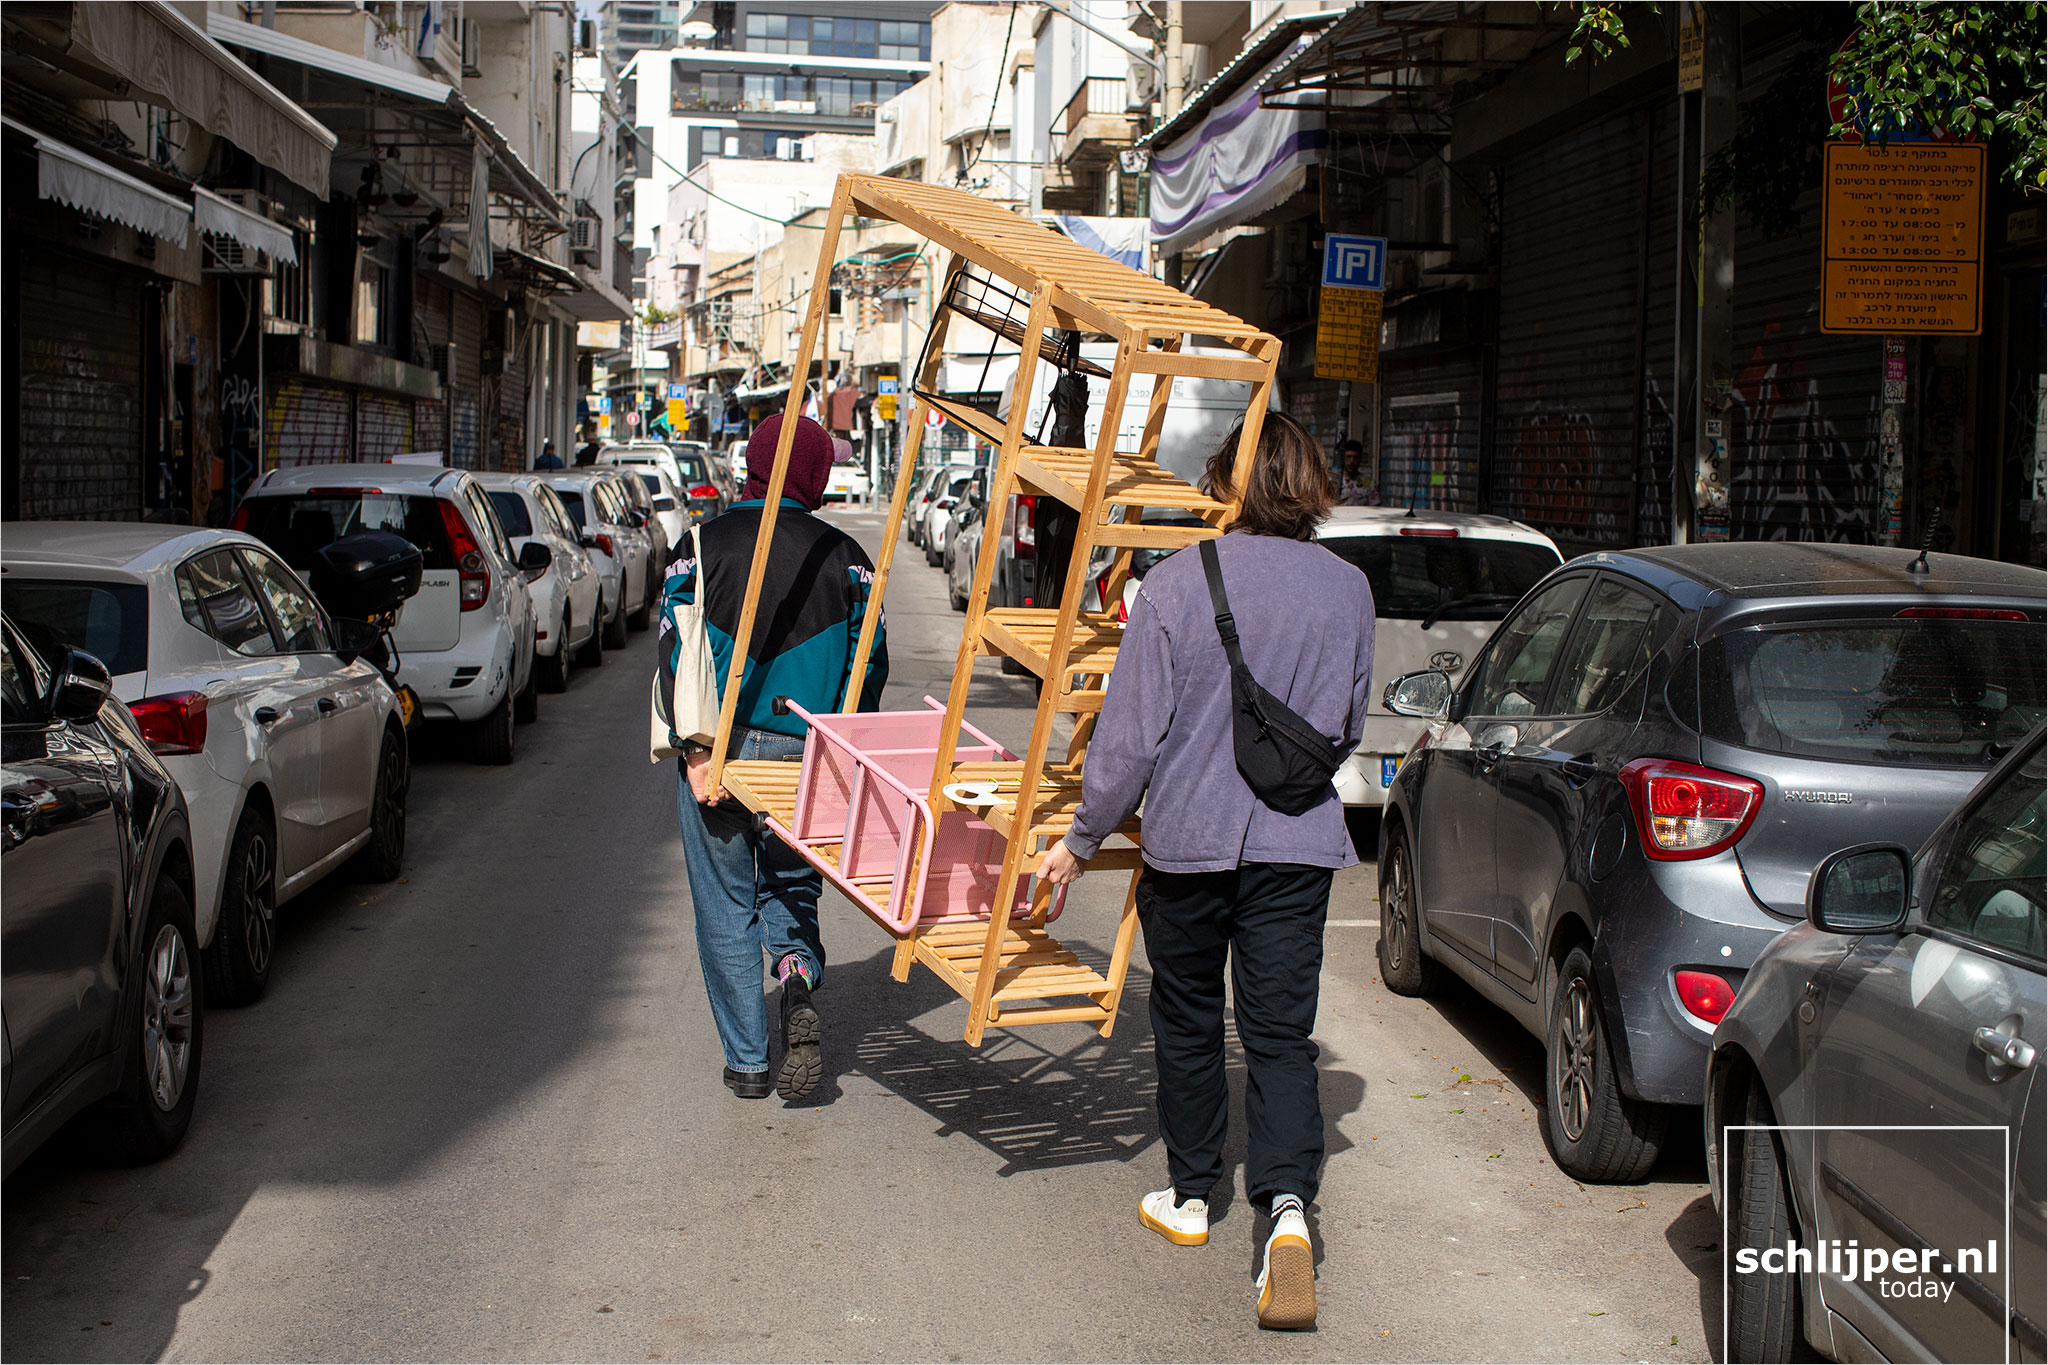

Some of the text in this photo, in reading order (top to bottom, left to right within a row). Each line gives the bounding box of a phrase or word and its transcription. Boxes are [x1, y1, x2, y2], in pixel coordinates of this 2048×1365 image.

[1911, 151, 1947, 159] בתוקף
[1834, 164, 1976, 174] פריקה וטעינה רציפה מותרת
[1878, 179, 1925, 187] המוגדרים
[1951, 178, 1973, 187] לכלי
[1878, 207, 1892, 215] עד
[1909, 208, 1939, 216] בימים
[1841, 220, 1877, 228] 17:00
[1881, 221, 1898, 229] עד
[1902, 221, 1941, 229] 08:00
[1878, 234, 1905, 242] וערבי
[1917, 235, 1939, 243] בימי
[1841, 247, 1877, 255] 13:00
[1881, 248, 1898, 256] עד
[1902, 248, 1941, 256] 08:00
[1346, 252, 1366, 279] P
[1895, 265, 1927, 273] הימים
[1931, 266, 1958, 274] ביתר
[1847, 278, 1956, 288] החניה במקום החניה
[1850, 291, 1891, 299] לתמרור
[1893, 292, 1927, 300] הצמוד
[1930, 294, 1967, 302] הראשון
[1863, 304, 1936, 313] מיועדת לרכב
[1845, 316, 1872, 324] בלבד
[1918, 318, 1953, 326] הנושא
[1784, 791, 1853, 804] HYUNDAI
